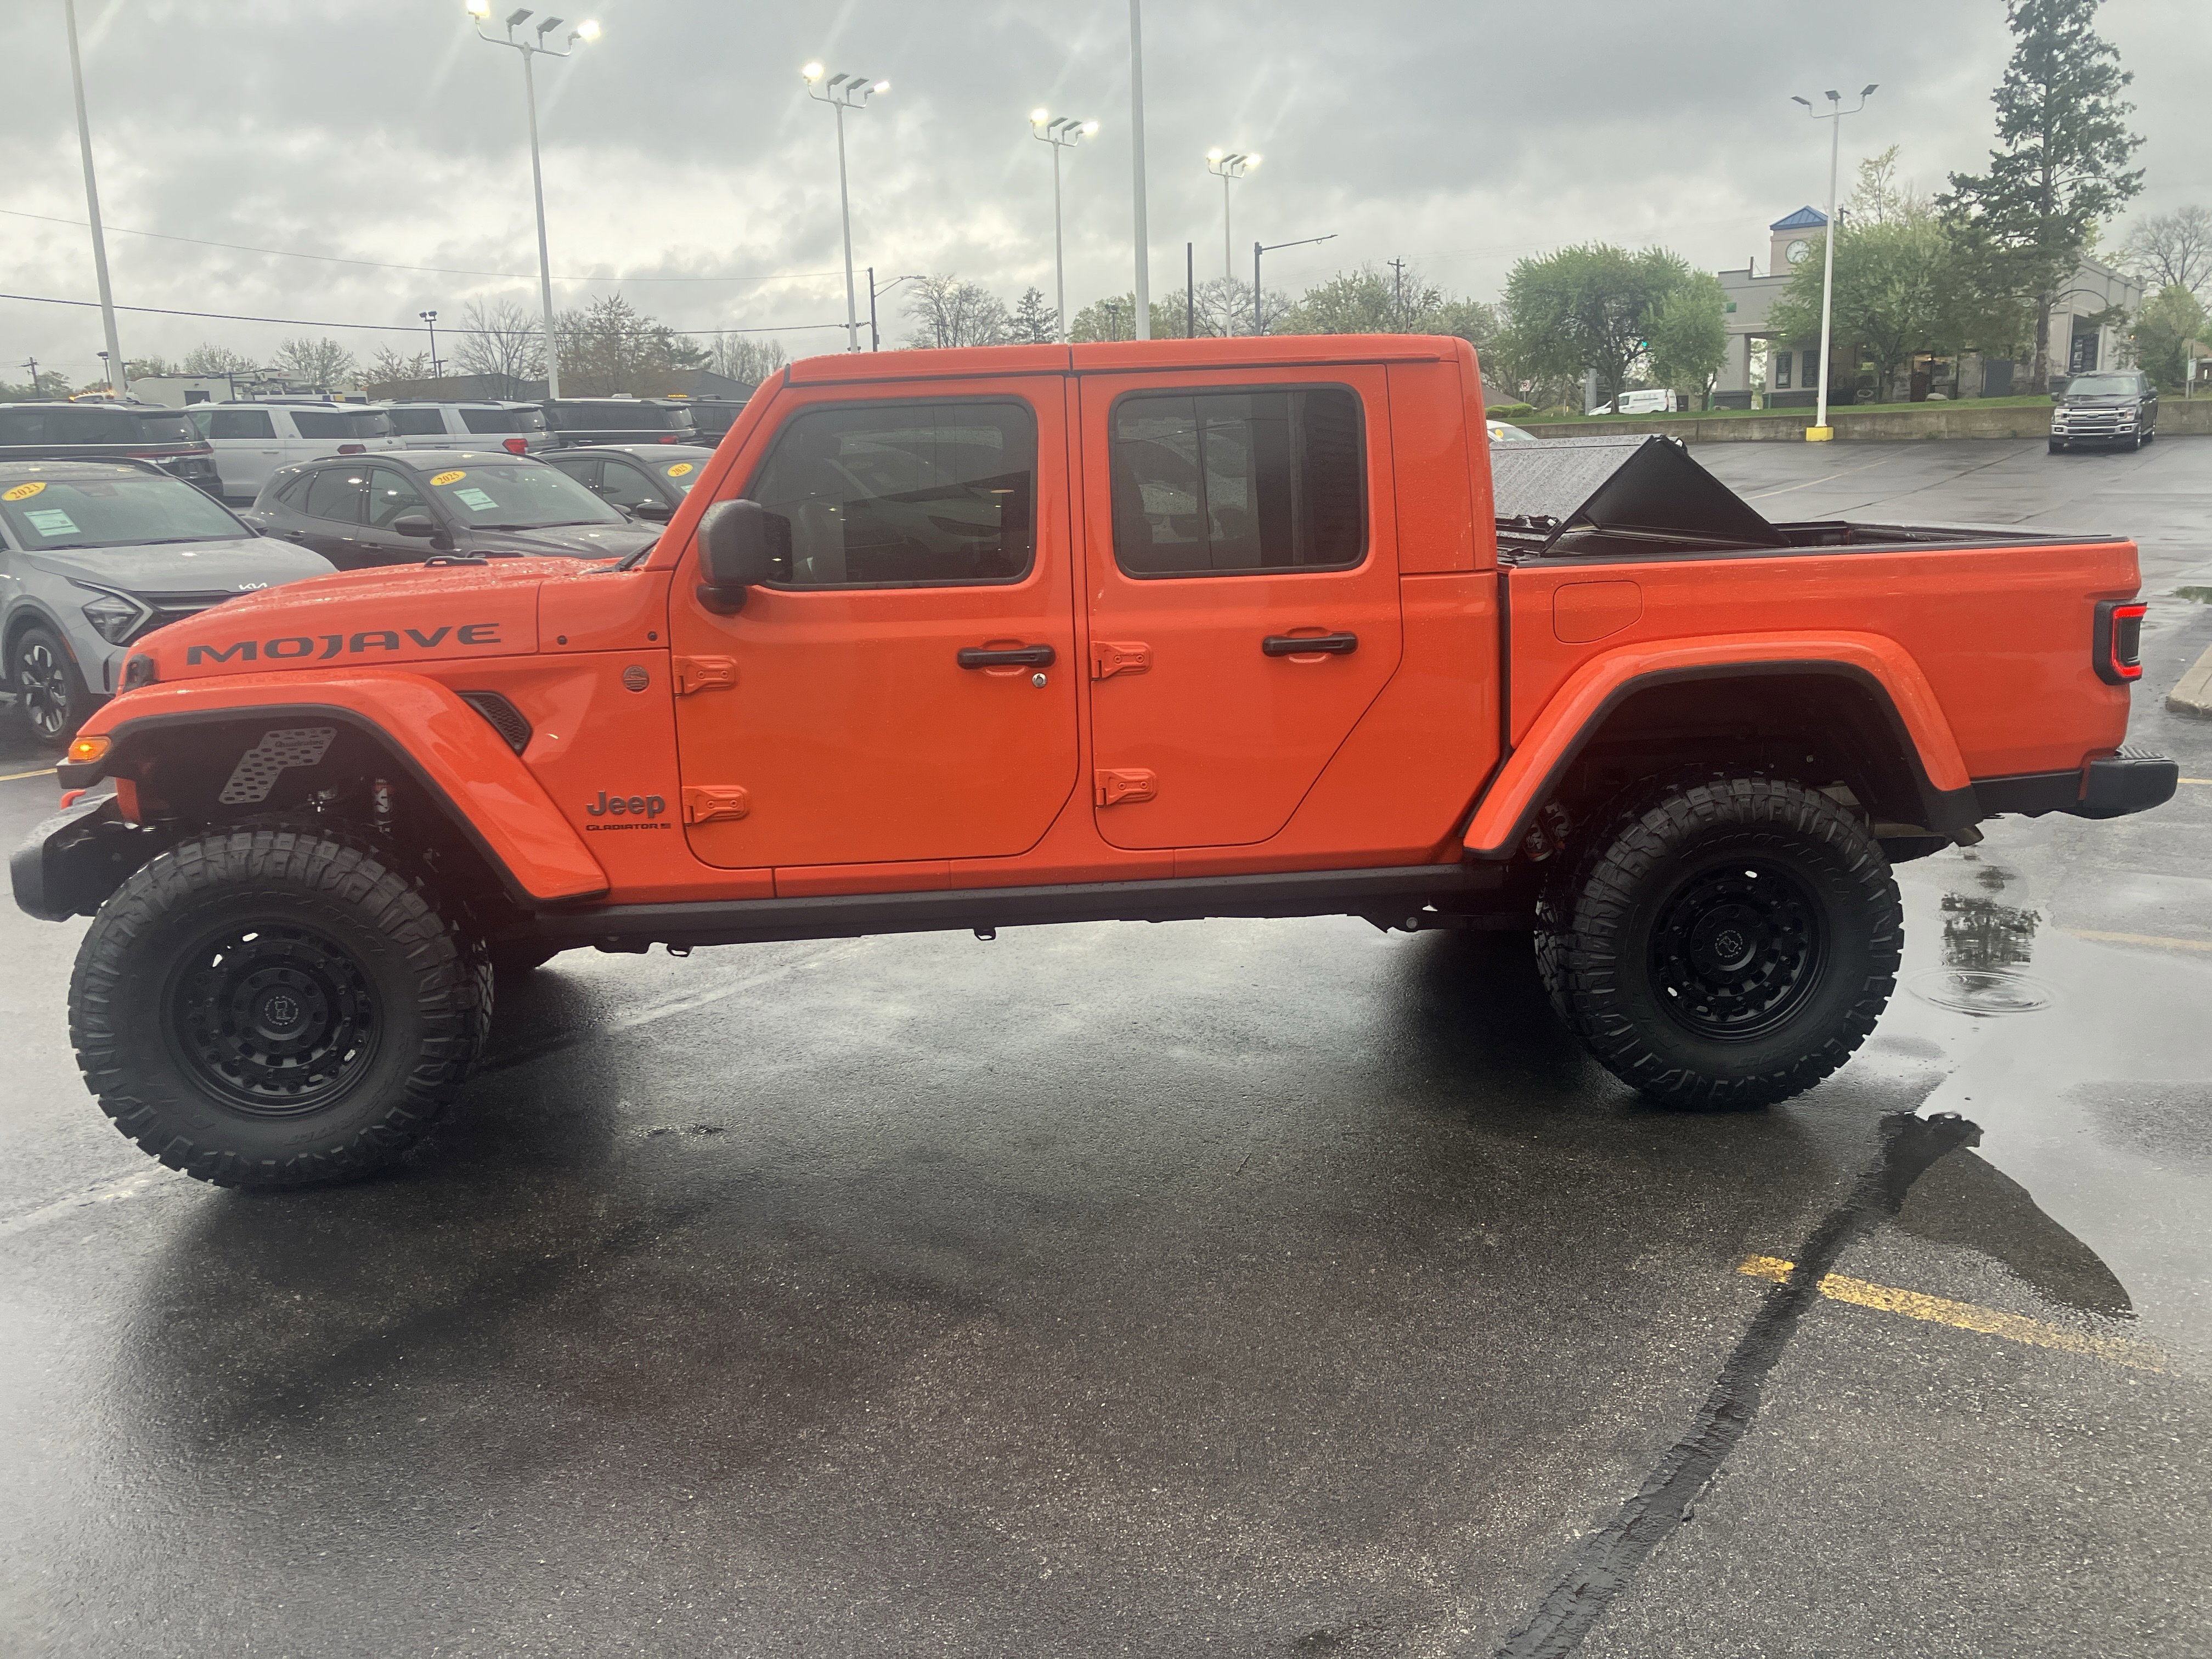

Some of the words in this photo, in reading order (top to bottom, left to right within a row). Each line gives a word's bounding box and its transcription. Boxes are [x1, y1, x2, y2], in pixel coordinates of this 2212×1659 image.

[672, 464, 688, 475] 2025
[437, 472, 460, 484] 2025
[10, 484, 40, 499] 2023
[187, 623, 501, 665] MOJAVE
[585, 790, 665, 819] Jeep
